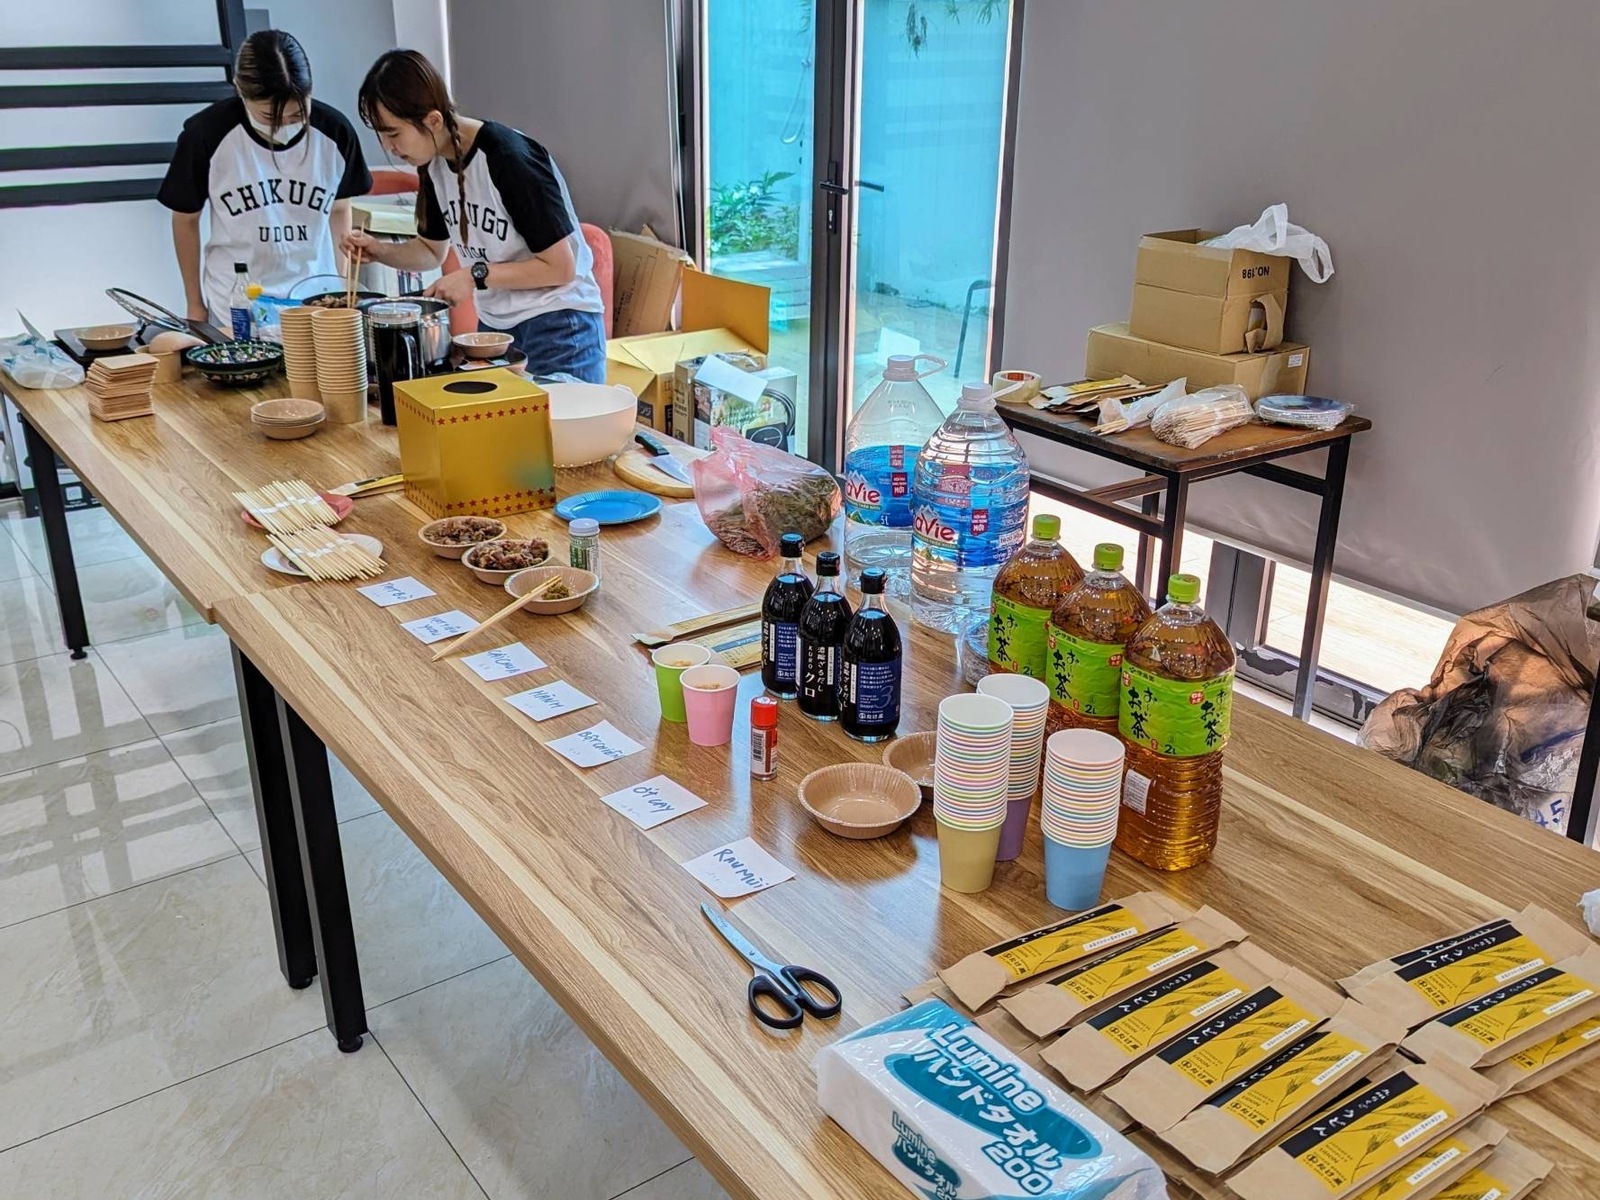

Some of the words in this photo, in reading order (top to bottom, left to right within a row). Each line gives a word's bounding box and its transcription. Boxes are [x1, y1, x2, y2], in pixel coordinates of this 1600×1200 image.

[259, 225, 308, 242] UDON
[1242, 266, 1270, 279] NO.198
[805, 671, 816, 698] クロ
[1053, 649, 1072, 699] お茶
[1085, 704, 1097, 714] 2L
[1128, 686, 1150, 739] お茶
[1164, 744, 1176, 755] 2L
[1425, 949, 1463, 968] うどん
[1118, 990, 1158, 1013] うどん
[1468, 992, 1505, 1012] うどん
[1187, 1021, 1225, 1045] うどん
[932, 1022, 1046, 1114] Lumine
[912, 1048, 1063, 1170] ハンドタオル
[1313, 1109, 1355, 1137] うどん
[892, 1111, 937, 1166] Lumine
[896, 1135, 957, 1197] ハンドタオル
[981, 1141, 1052, 1196] 200
